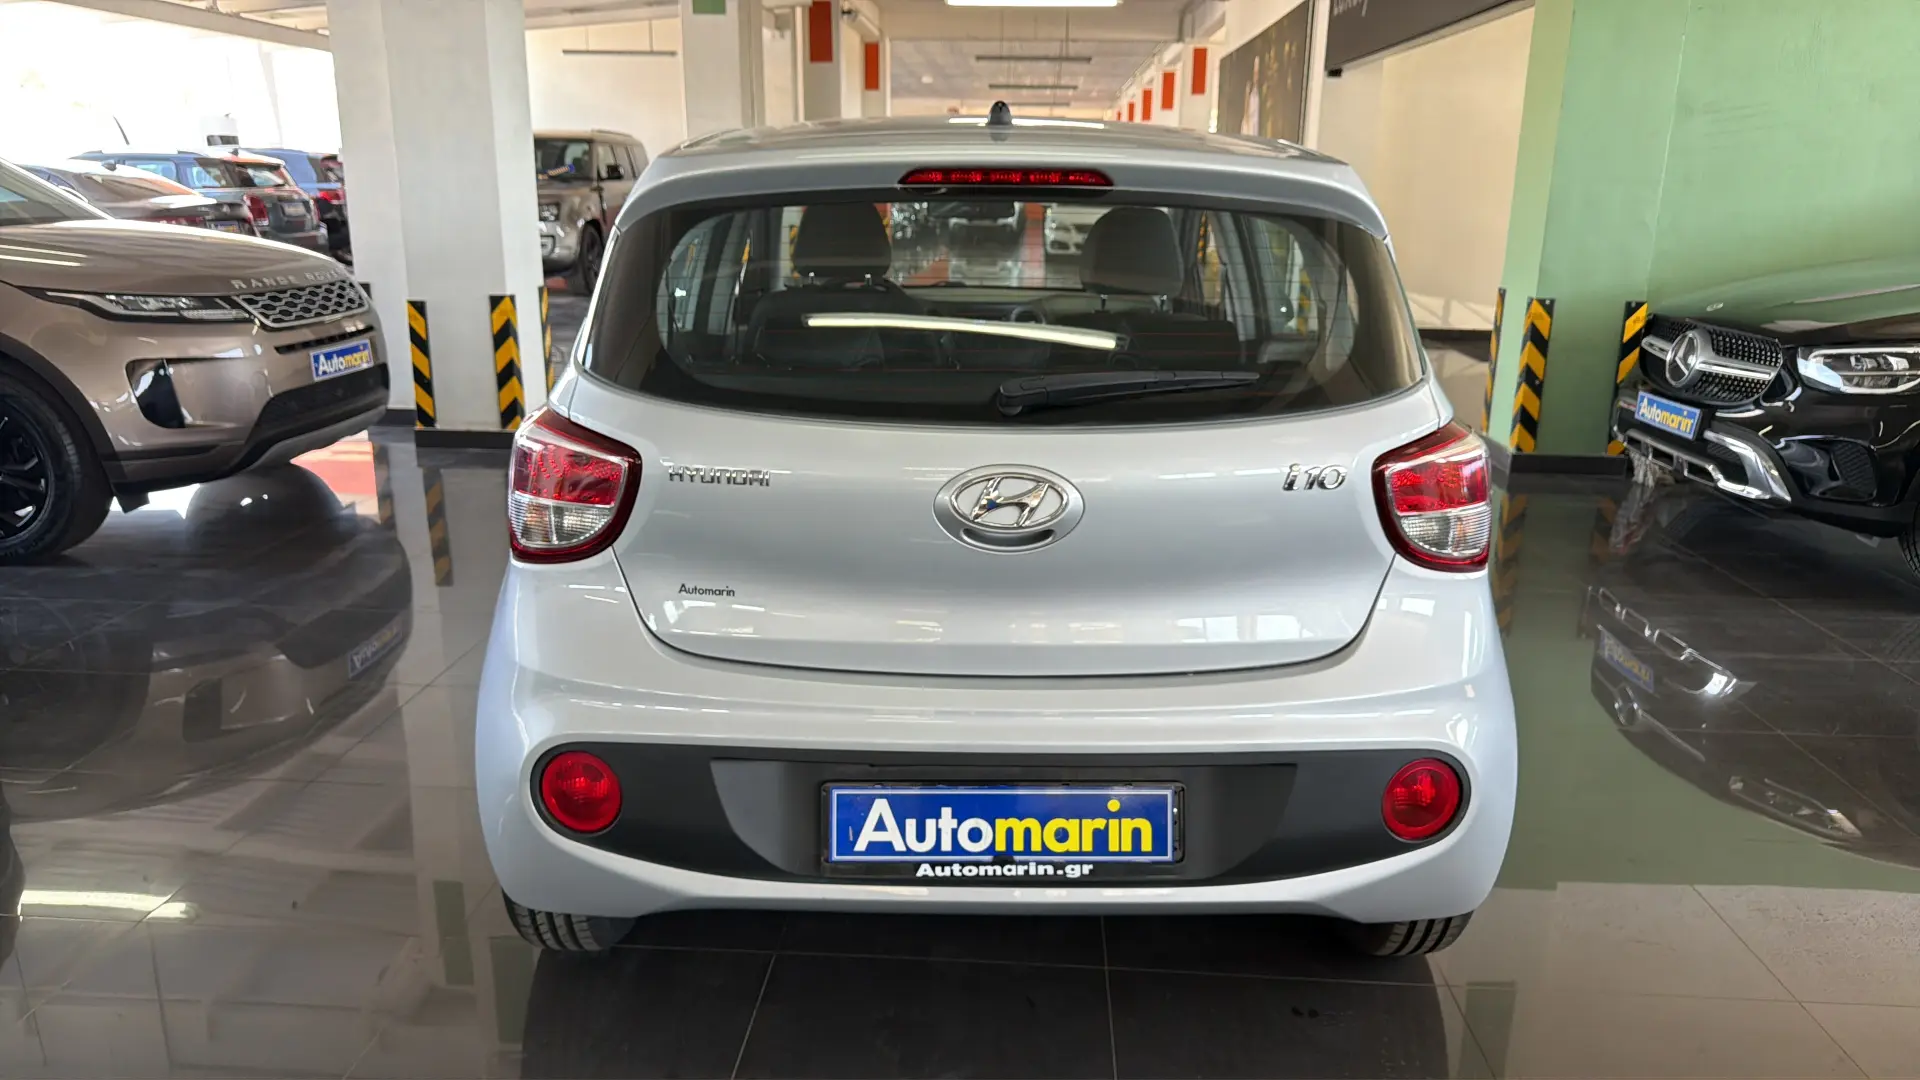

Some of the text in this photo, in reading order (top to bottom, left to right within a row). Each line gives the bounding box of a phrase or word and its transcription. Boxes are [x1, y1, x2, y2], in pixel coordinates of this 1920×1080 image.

[231, 275, 299, 290] RANGE
[318, 344, 370, 377] Automarin
[1640, 395, 1692, 433] Automarin
[667, 465, 770, 487] HYUNDAI
[1282, 463, 1348, 491] i10
[678, 582, 736, 597] Automarin
[853, 798, 1153, 853] Automarin
[916, 862, 1094, 878] Automarin.gr
